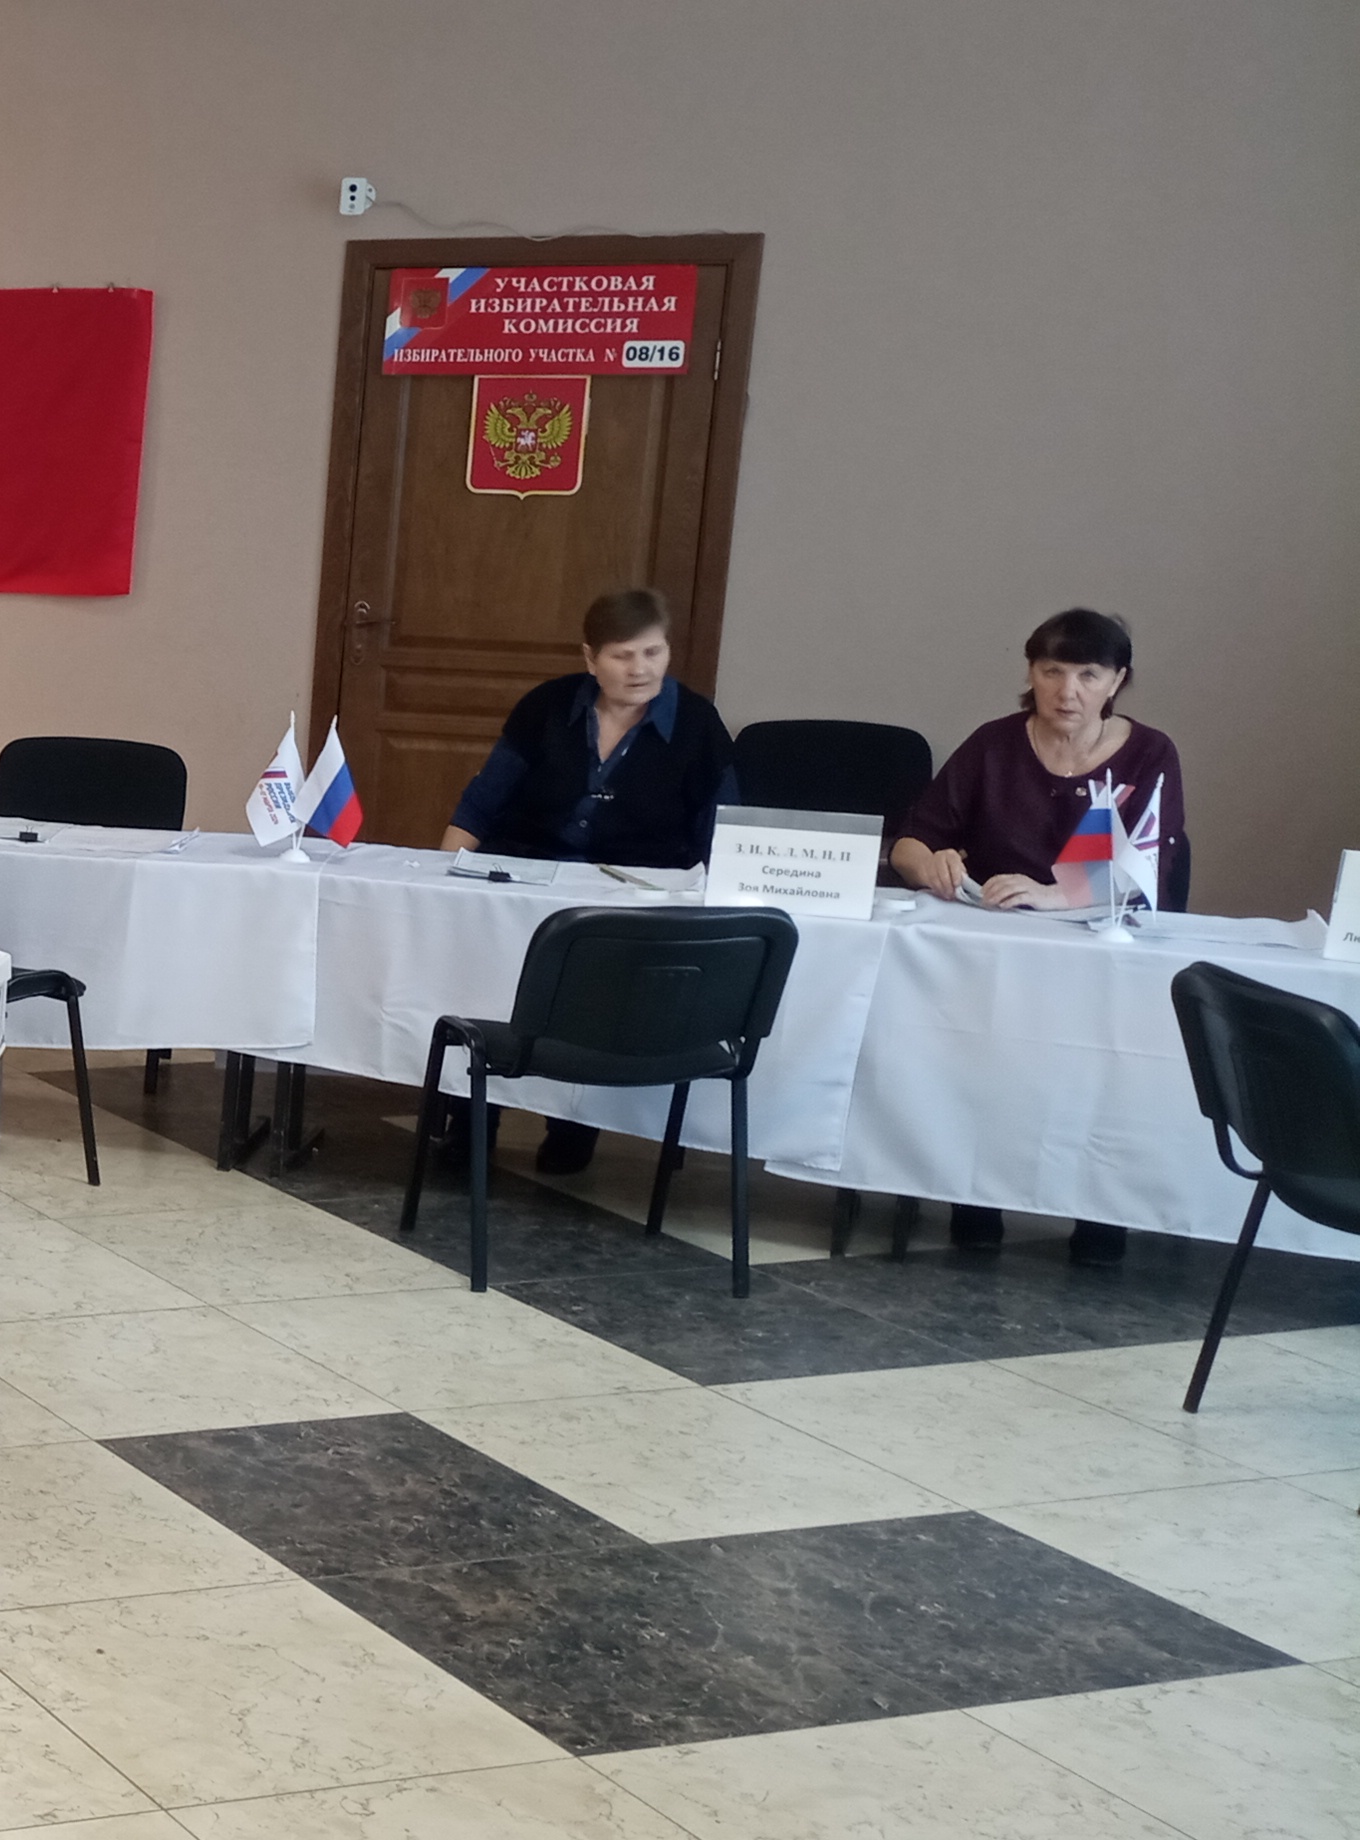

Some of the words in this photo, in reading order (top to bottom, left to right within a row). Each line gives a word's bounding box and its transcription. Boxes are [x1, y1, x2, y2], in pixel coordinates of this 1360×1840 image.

[495, 275, 656, 293] УЧАСТКОВАЯ
[469, 296, 677, 314] ИЗБИРАТЕЛЬНАЯ
[502, 318, 640, 334] КОМИССИЯ
[393, 347, 522, 363] ИЗБИРАТЕЛЬНОГО
[529, 347, 595, 363] УЧАСТКА
[625, 345, 681, 363] 08/16
[762, 865, 821, 879] Середина
[738, 882, 759, 893] Зоя
[762, 884, 840, 899] Михайловна
